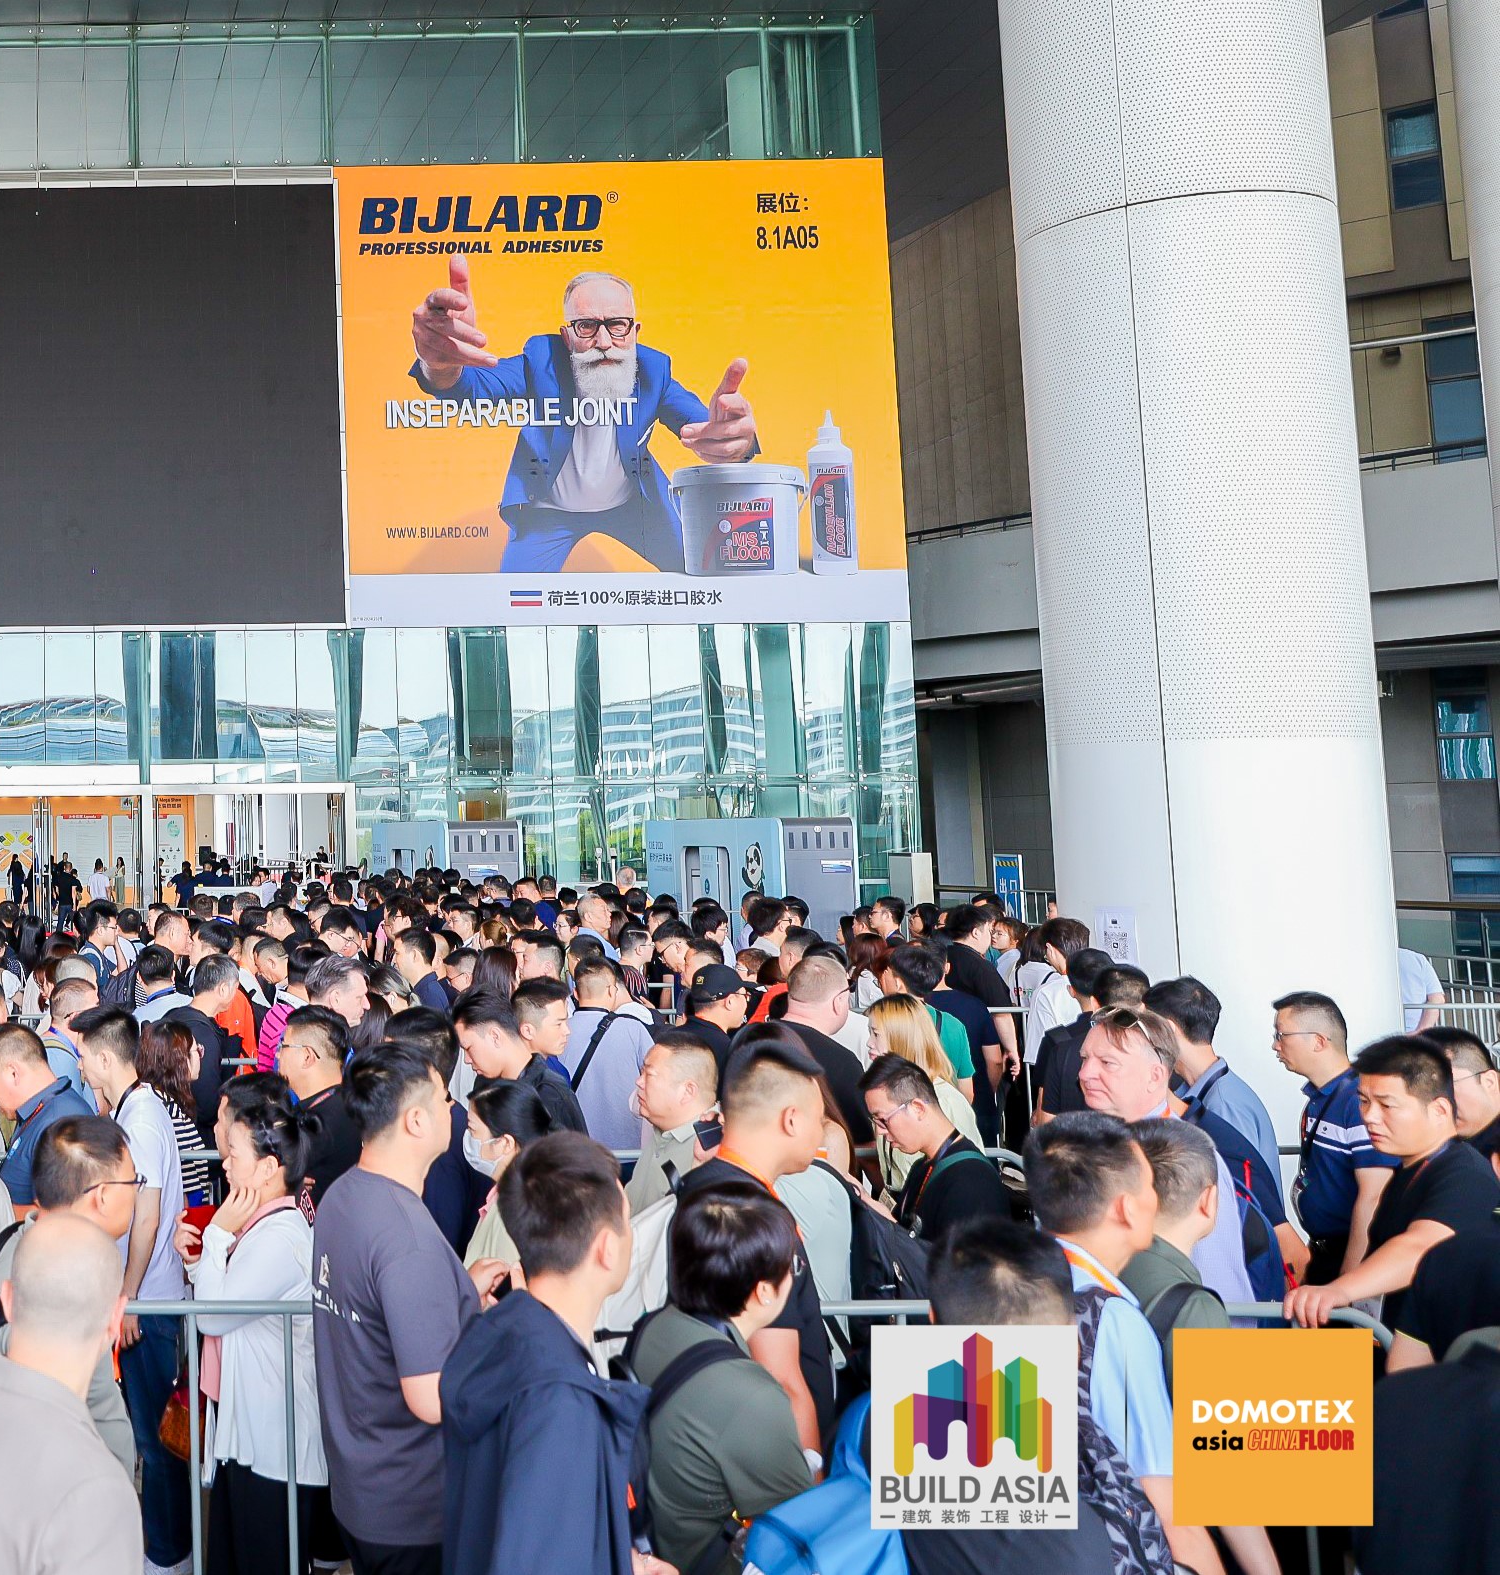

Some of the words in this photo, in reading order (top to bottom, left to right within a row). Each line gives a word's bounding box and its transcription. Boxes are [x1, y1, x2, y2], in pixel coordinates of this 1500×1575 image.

[358, 194, 603, 235] BIJLARD
[756, 225, 819, 250] 8.1A05
[358, 240, 493, 256] PROFESSIONAL
[501, 239, 604, 254] ADHESIVES
[386, 398, 561, 429] INSEPARABLE
[564, 397, 638, 426] JOINT
[716, 501, 770, 513] BIJLARD
[385, 526, 489, 539] WWW.BIJLARD.COM
[732, 531, 758, 546] MS
[720, 545, 771, 561] FLOOR
[547, 590, 723, 607] 荷兰100%原装进口胶水
